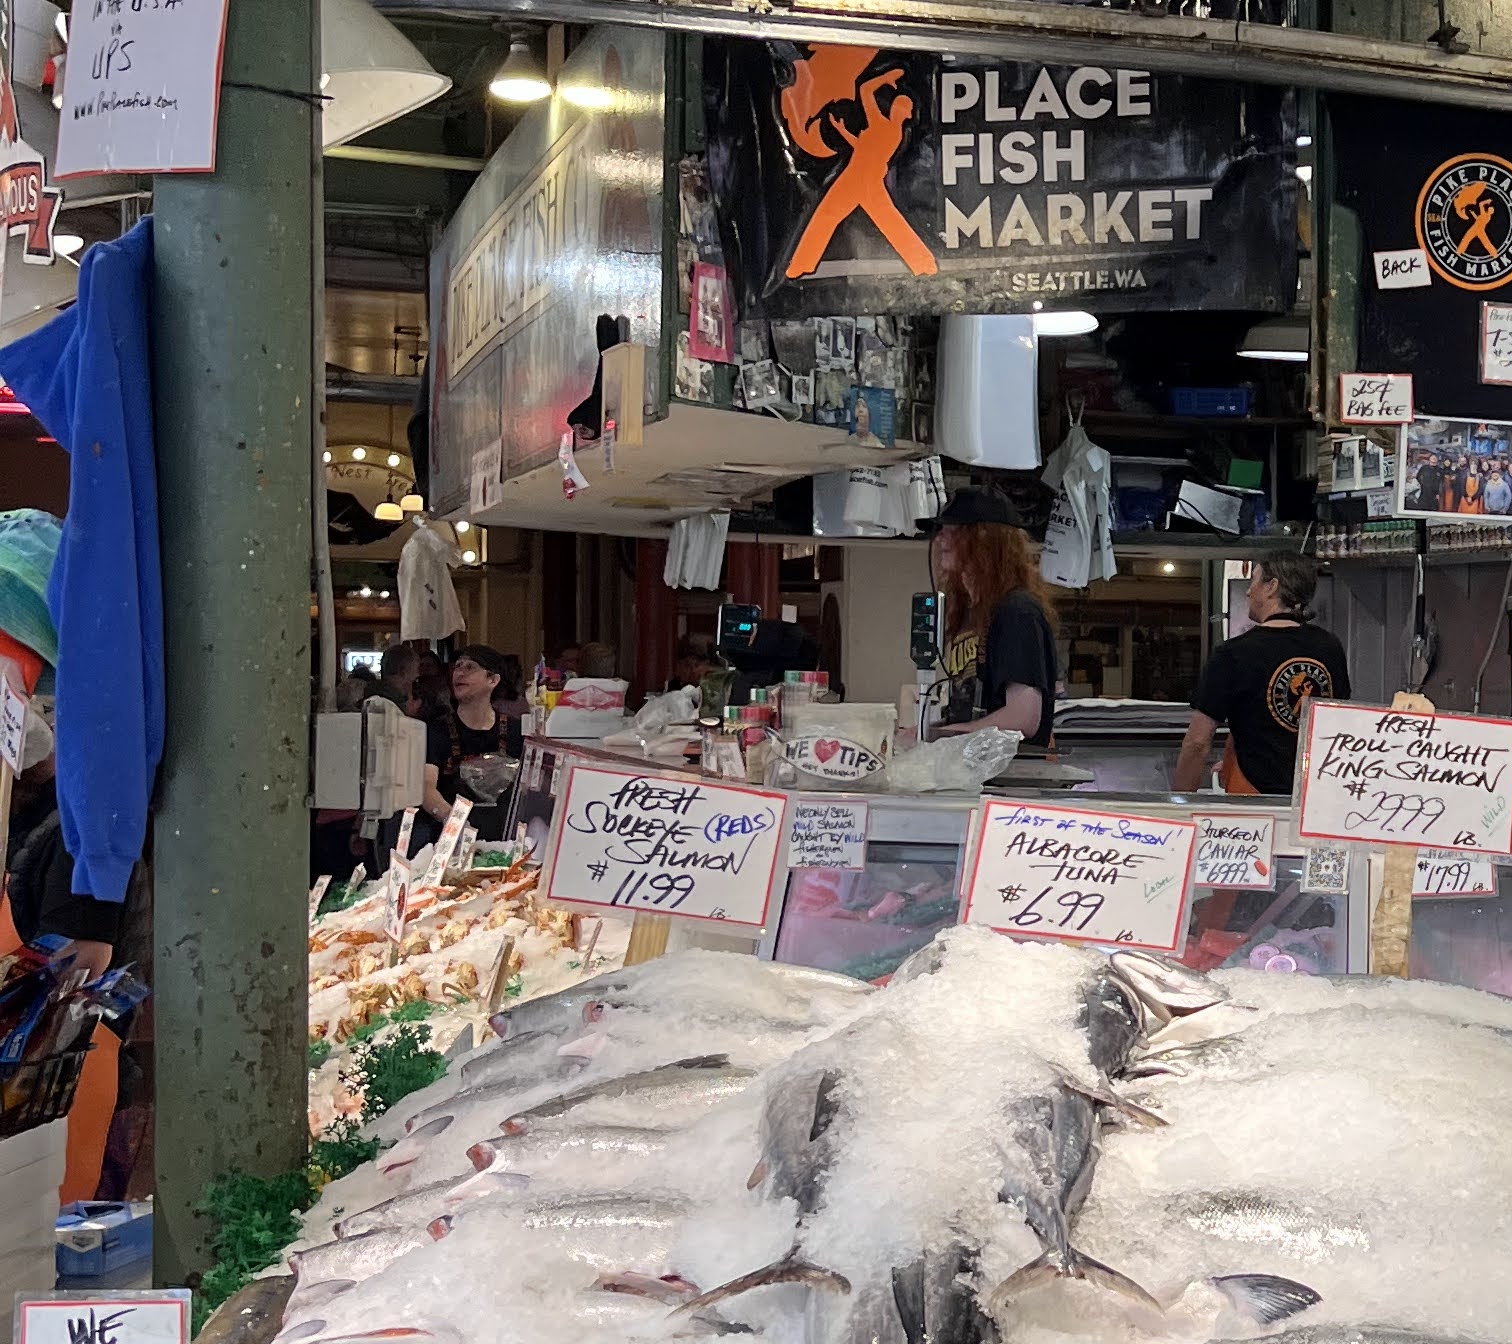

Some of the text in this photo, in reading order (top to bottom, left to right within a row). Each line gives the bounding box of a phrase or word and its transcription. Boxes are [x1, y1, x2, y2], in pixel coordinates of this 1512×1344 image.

[91, 38, 135, 80] UPS
[941, 66, 1152, 125] PLACE
[941, 129, 1086, 187] FISH
[1431, 168, 1469, 207] PIKE
[944, 187, 1214, 250] MARKET
[1429, 228, 1459, 268] FISH
[1381, 257, 1422, 280] BACK
[1346, 399, 1375, 418] BAG
[1375, 711, 1442, 740] FRESH
[785, 739, 879, 772] WE TIPS
[1317, 751, 1508, 794] KING SALMON
[609, 775, 707, 815] FRESH
[567, 800, 778, 845] SOCKEYE (REDS)
[994, 806, 1055, 829] FIRST
[1056, 817, 1076, 831] OF
[1081, 821, 1114, 837] THE
[1196, 817, 1270, 844] STURGEON
[604, 832, 758, 875] SALMON
[1004, 830, 1165, 869] ALBACORE
[1198, 839, 1262, 862] CAVIAR
[1028, 860, 1139, 886] TUNA
